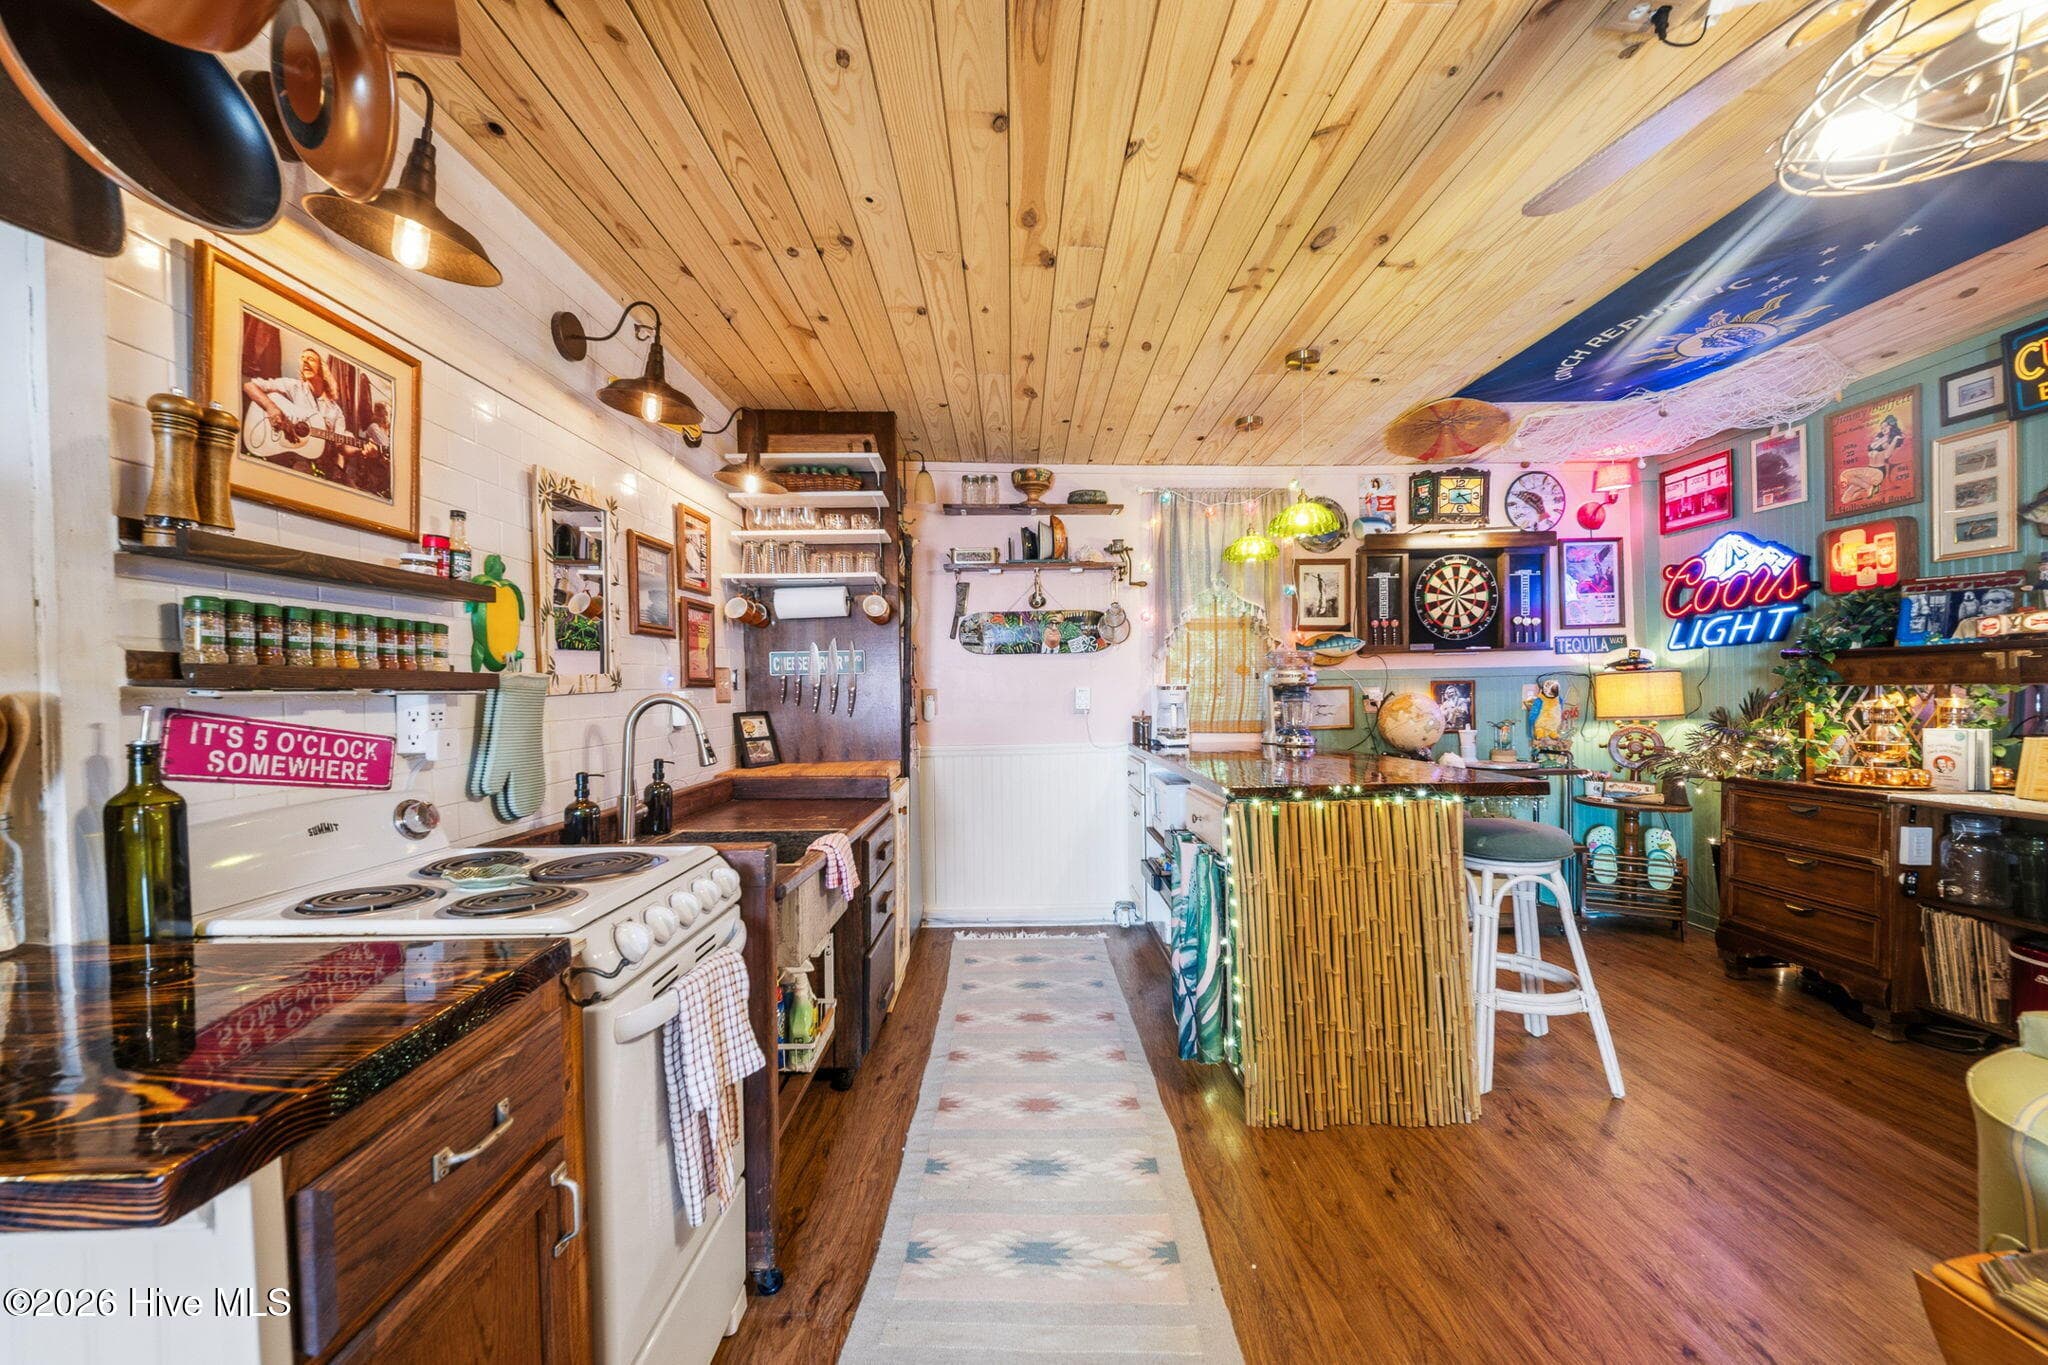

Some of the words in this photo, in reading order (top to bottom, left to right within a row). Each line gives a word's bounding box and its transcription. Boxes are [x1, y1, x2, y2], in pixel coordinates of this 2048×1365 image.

[1455, 479, 1466, 488] 12
[1473, 492, 1480, 500] 3
[1456, 504, 1464, 513] 6
[1664, 556, 1809, 617] Coors
[1668, 606, 1799, 650] LIGHT
[1557, 636, 1610, 654] TEQUILA
[1609, 636, 1625, 644] WAY
[189, 721, 245, 749] IT'S
[253, 729, 268, 751] 5
[276, 732, 379, 761] O'CLOCK
[207, 750, 369, 782] SOMEWHERE
[307, 822, 340, 837] SUMMIT
